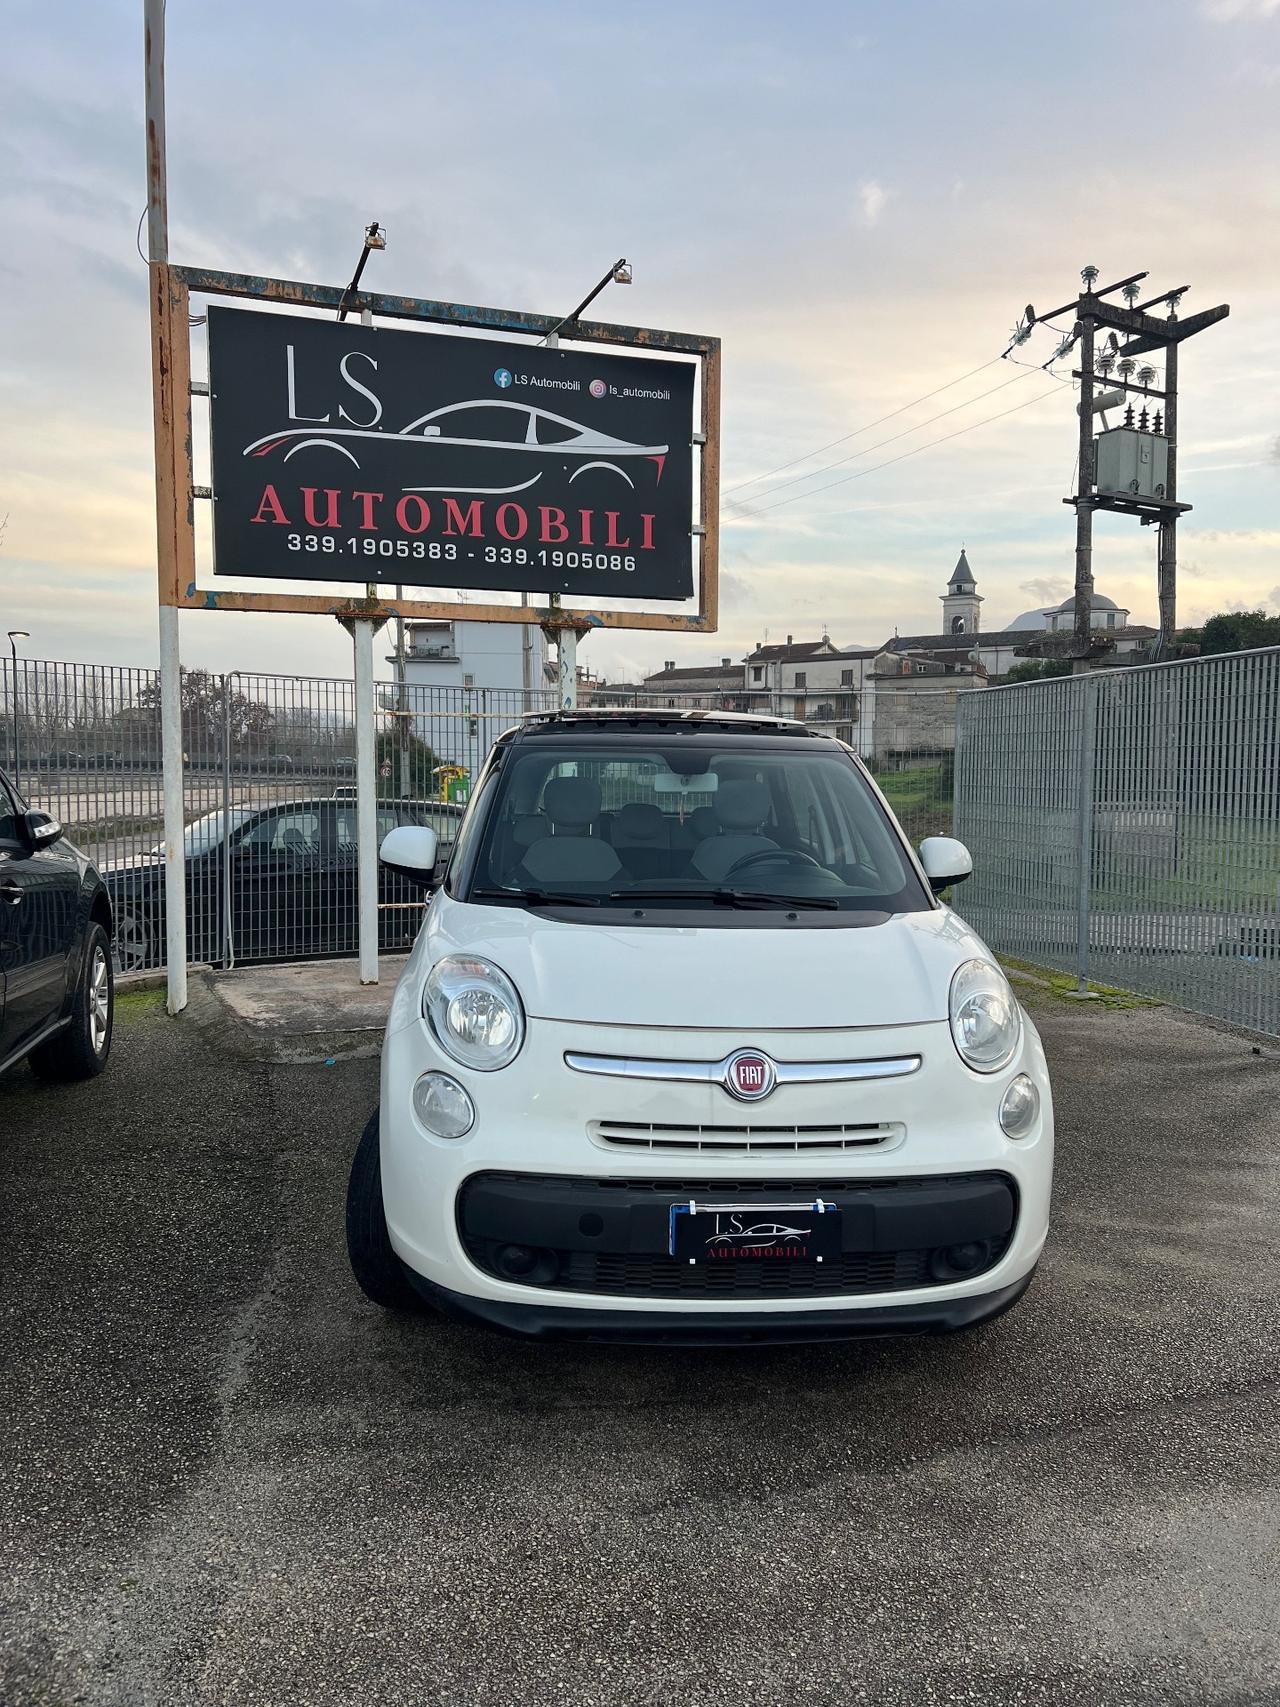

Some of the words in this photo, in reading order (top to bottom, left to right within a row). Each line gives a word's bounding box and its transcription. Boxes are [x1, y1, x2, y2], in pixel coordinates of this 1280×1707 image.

[286, 344, 383, 428] LS
[514, 374, 528, 386] LS
[530, 376, 581, 391] Automobili
[609, 384, 671, 400] ls_automobili
[249, 484, 656, 550] AUTOMOBILI
[286, 533, 458, 561] 339.1905383
[484, 546, 636, 572] 339.1905086
[739, 1066, 763, 1085] FIAT
[715, 1213, 744, 1235] LS
[706, 1246, 808, 1259] AUTOMOBILI
